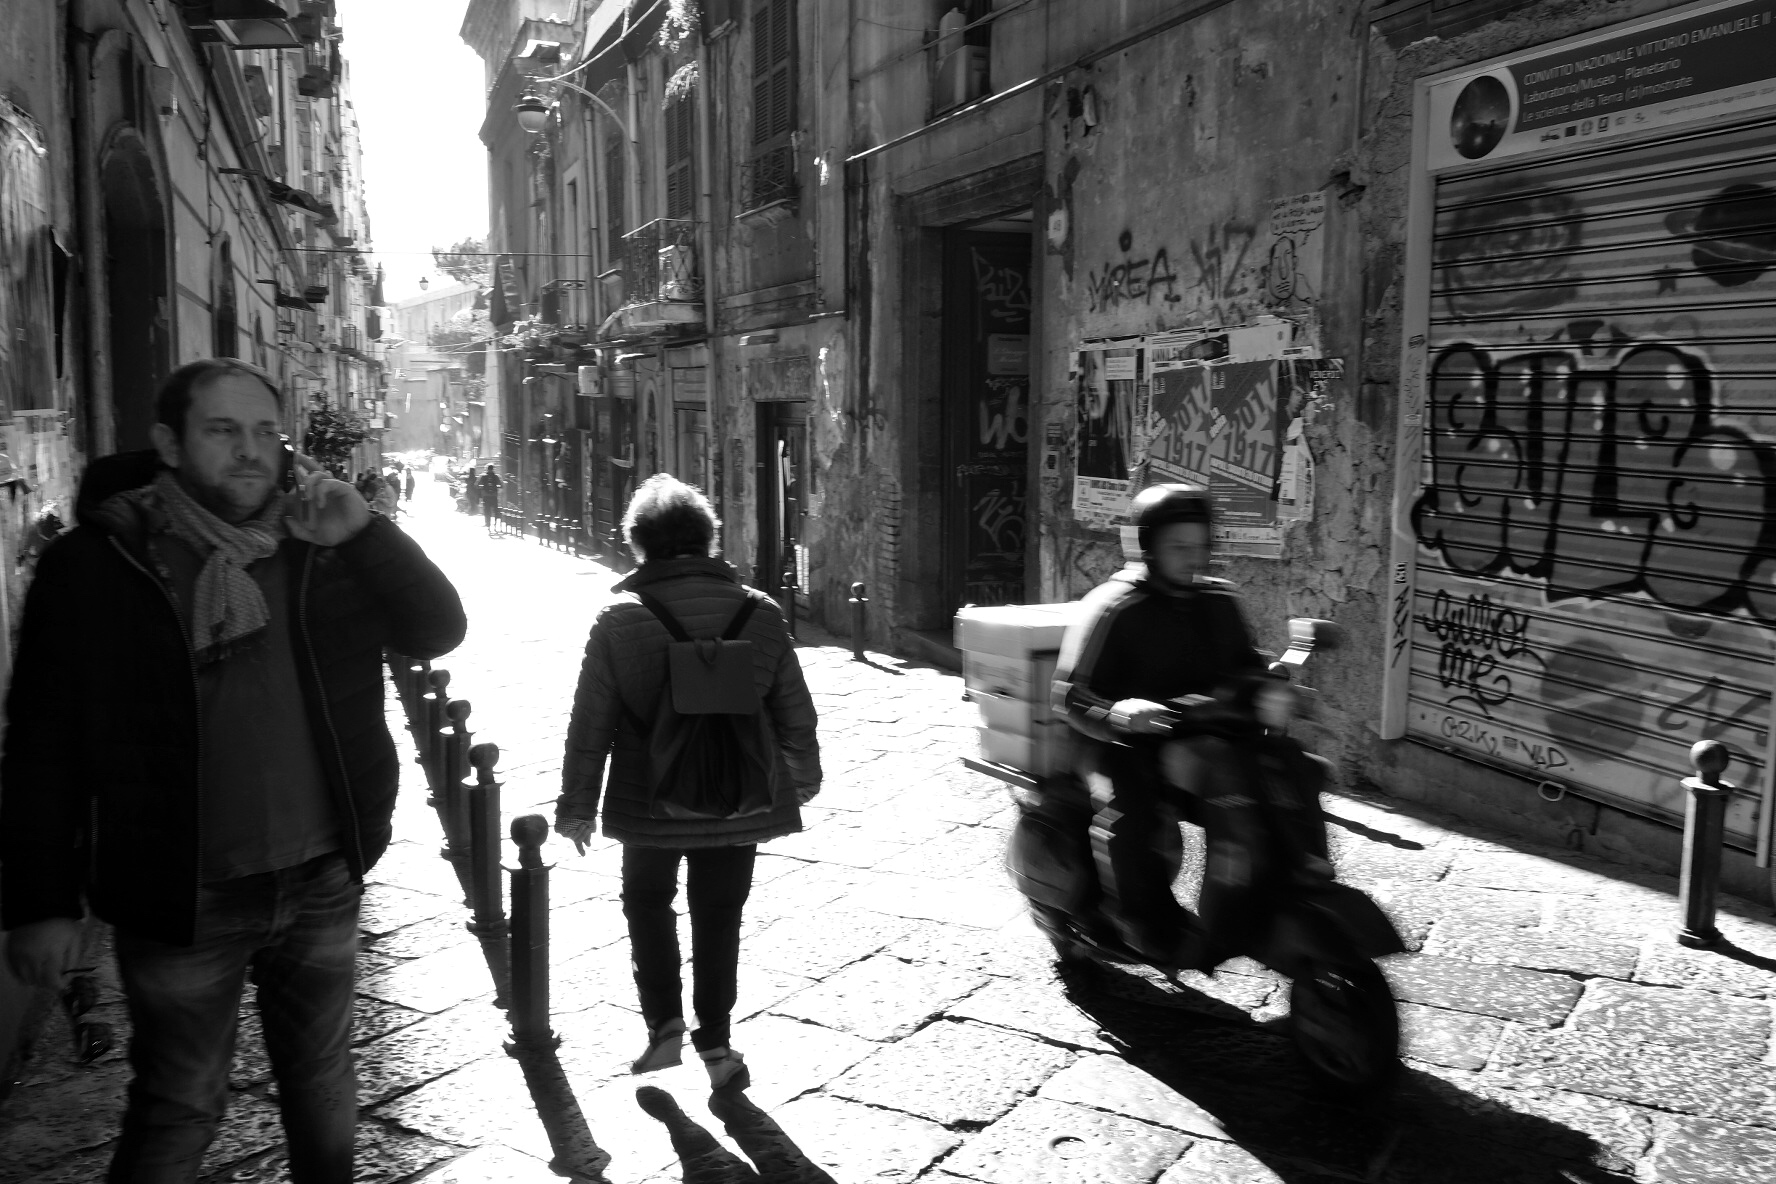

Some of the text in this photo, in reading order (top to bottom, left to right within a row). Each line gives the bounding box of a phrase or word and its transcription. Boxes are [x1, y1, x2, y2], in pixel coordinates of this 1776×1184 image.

[1523, 63, 1572, 86] CONVITTO
[1575, 48, 1633, 73] NAZIONALE
[1636, 33, 1689, 57] VITTORIO
[1690, 14, 1760, 44] EMANUELE
[1523, 74, 1617, 105] Laboratorio/Museo
[1625, 57, 1682, 81] Planetario
[1522, 109, 1534, 123] Le
[1535, 102, 1569, 120] scienze
[1571, 96, 1596, 114] della
[1597, 88, 1623, 106] Terra
[1223, 431, 1277, 474] 1917
